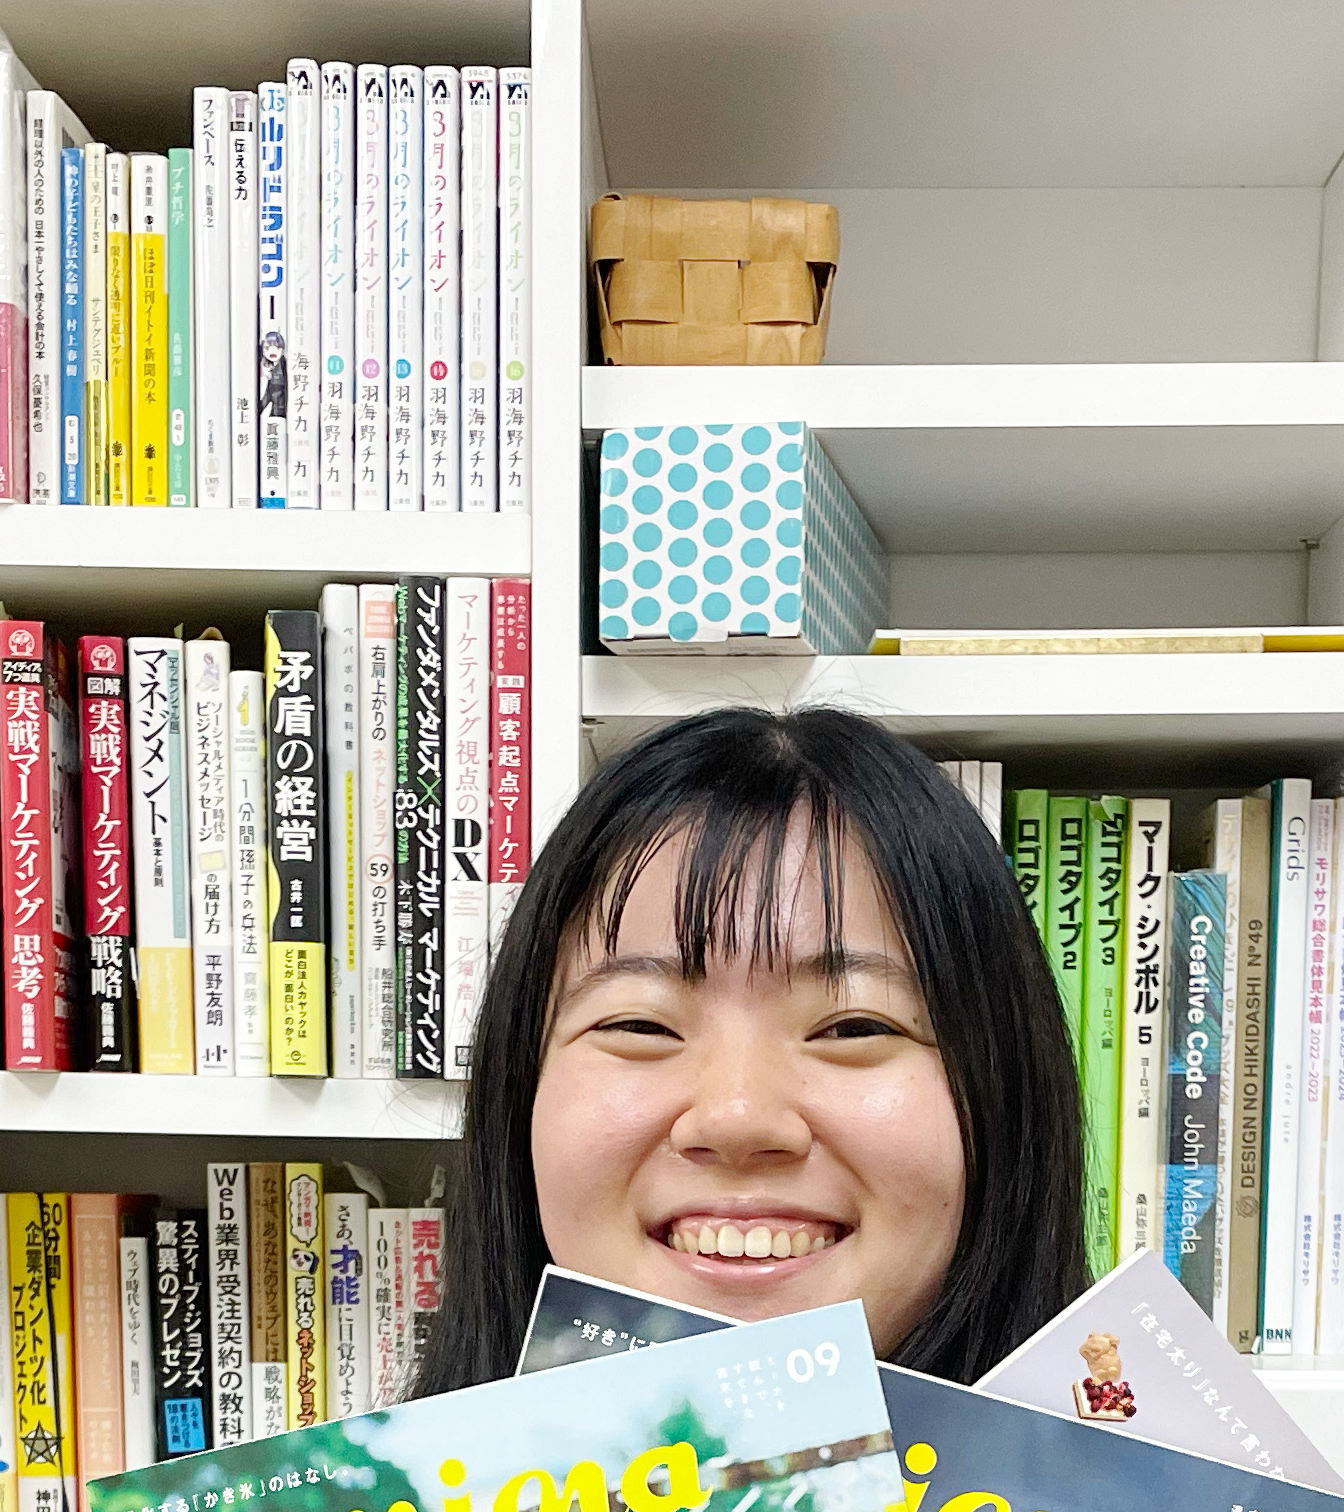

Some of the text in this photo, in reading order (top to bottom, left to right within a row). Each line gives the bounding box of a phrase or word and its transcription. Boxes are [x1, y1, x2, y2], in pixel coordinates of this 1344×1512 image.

[170, 165, 186, 226] プチ哲学
[201, 98, 216, 167] ファンベース
[234, 137, 248, 201] 伝える力
[428, 110, 450, 292] 3月のライオン
[33, 118, 46, 360] 経理以外の人のための 日本一やさしくて使える会計の本
[65, 165, 79, 378] 神の子どもたちはみな踊る 村上春樹
[109, 245, 123, 378] 限りなく透明に近いブルー
[142, 246, 156, 405] ほぼ日刊イトイ新聞の本
[323, 381, 343, 484] 羽海野チカ
[358, 384, 380, 484] 羽海野チカ
[393, 385, 413, 487] 羽海野チカ
[428, 386, 450, 488] 羽海野チカ
[467, 386, 487, 488] 羽海野チカ
[505, 386, 526, 488] 羽海野チカ
[87, 676, 123, 696] 図解
[134, 649, 171, 836] マネジメント
[273, 650, 318, 862] 矛盾の経営
[342, 626, 354, 752] ペパボの教科書
[451, 593, 484, 882] マーケティング視点の DX
[5, 686, 45, 999] 実戦マーケティング思考
[196, 700, 221, 936] ビジネスメッセージ の届け方
[211, 701, 226, 843] ソーシャルメディア時代の
[369, 644, 390, 952] 右肩上がりの 59 の打ち手
[415, 584, 443, 1075] ファンダメンタルズ×テクニカル マーケティング
[87, 700, 127, 999] 実戦マーケティング戦略
[152, 837, 165, 888] 基本と原則
[1057, 816, 1084, 971] ロゴタイプ2
[1284, 814, 1307, 884] Grids
[204, 954, 224, 1028] 平野友朗
[296, 949, 308, 1040] 面白法人カヤックは
[1133, 819, 1163, 1045] マーク・シンボル 5
[1308, 854, 1329, 1026] モリサワ総合書体見本帳
[1137, 1056, 1151, 1119] ヨーロッパ編
[1179, 912, 1215, 1257] Creative Code John Maeda
[1241, 975, 1262, 1190] DESIGN NO HIKIDASHI
[11, 1284, 30, 1435] プロジェクト
[24, 1220, 50, 1407] 企業ダントツ化
[124, 1250, 140, 1346] ウェブ時代をゆく
[156, 1219, 183, 1389] 驚異のプレゼン
[181, 1219, 205, 1390] スティーブ・ジョブズ
[330, 1204, 361, 1414] さあ、才能に目覚めよう
[785, 1341, 842, 1385] 09
[1265, 1326, 1293, 1342] BNN
